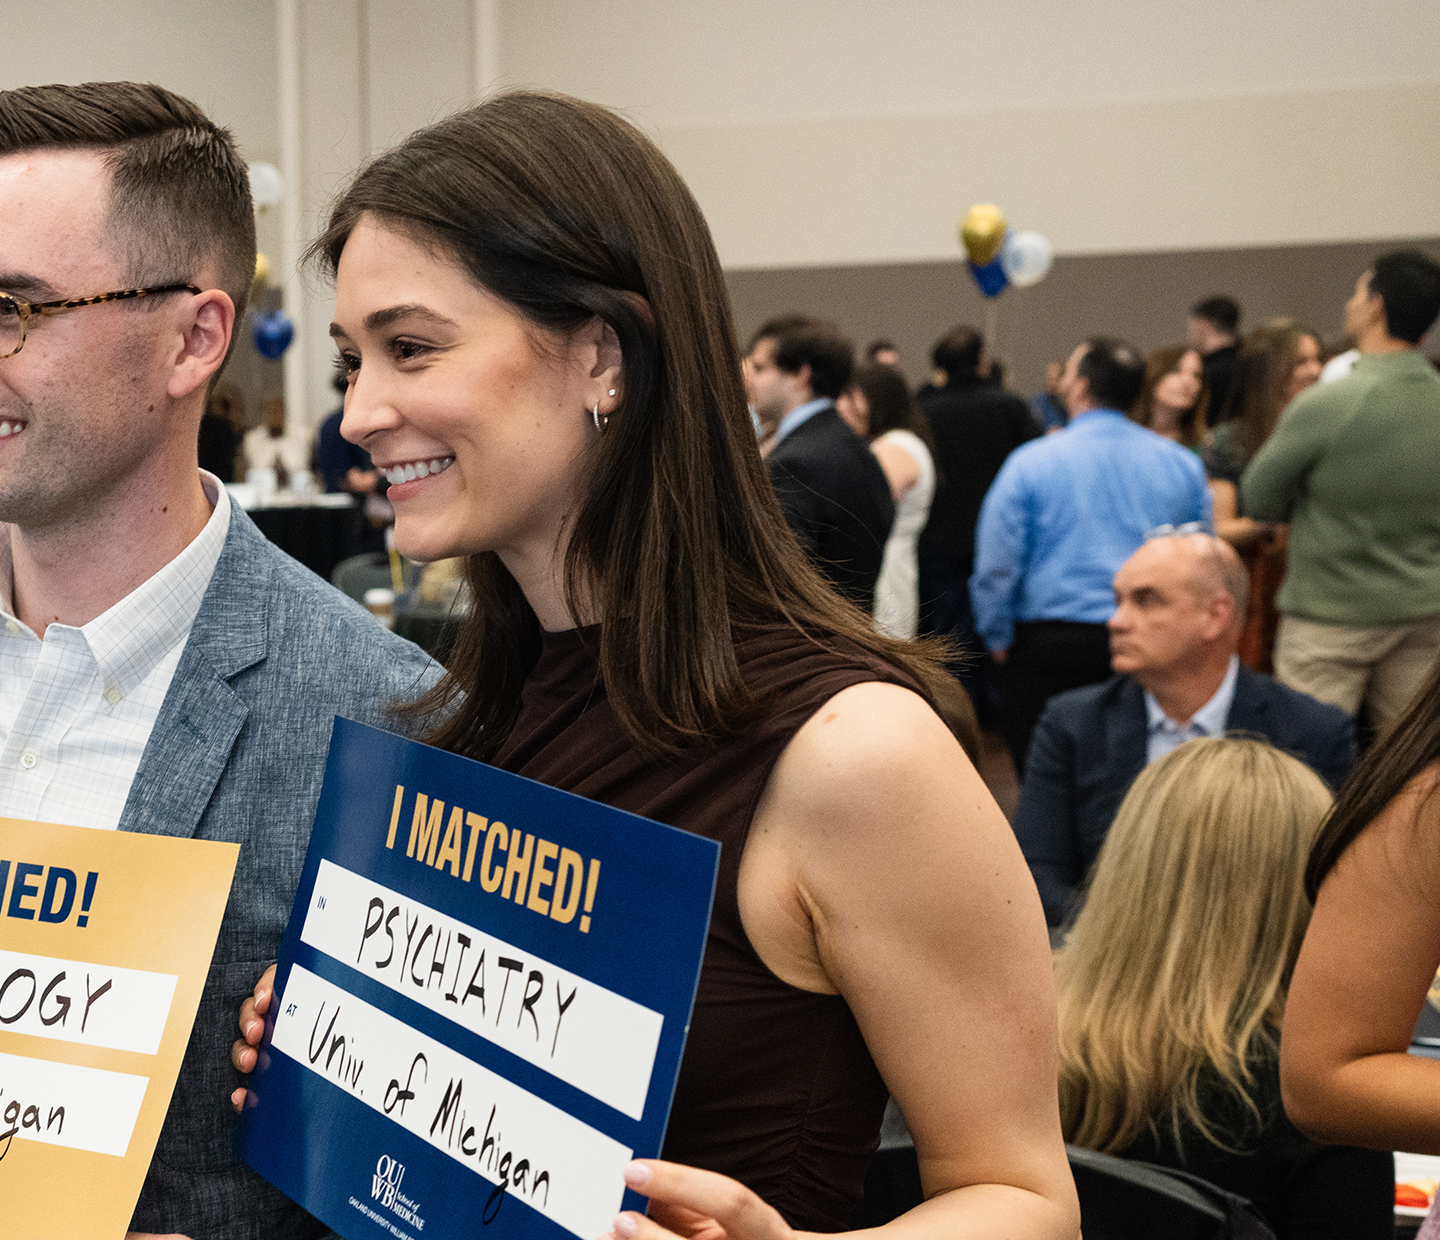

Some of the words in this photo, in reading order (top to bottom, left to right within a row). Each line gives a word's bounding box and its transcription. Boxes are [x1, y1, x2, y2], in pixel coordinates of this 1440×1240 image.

[385, 784, 404, 850] I
[406, 792, 601, 934] MATCHED!
[317, 896, 327, 910] IN
[357, 897, 577, 1058] PSYCHIATRY
[285, 1003, 298, 1017] AT
[309, 1000, 364, 1096] Univ.
[383, 1052, 428, 1117] of
[430, 1077, 550, 1225] Michigan
[376, 1154, 403, 1185] OU
[371, 1174, 395, 1207] WB
[392, 1201, 425, 1232] MEDICINE
